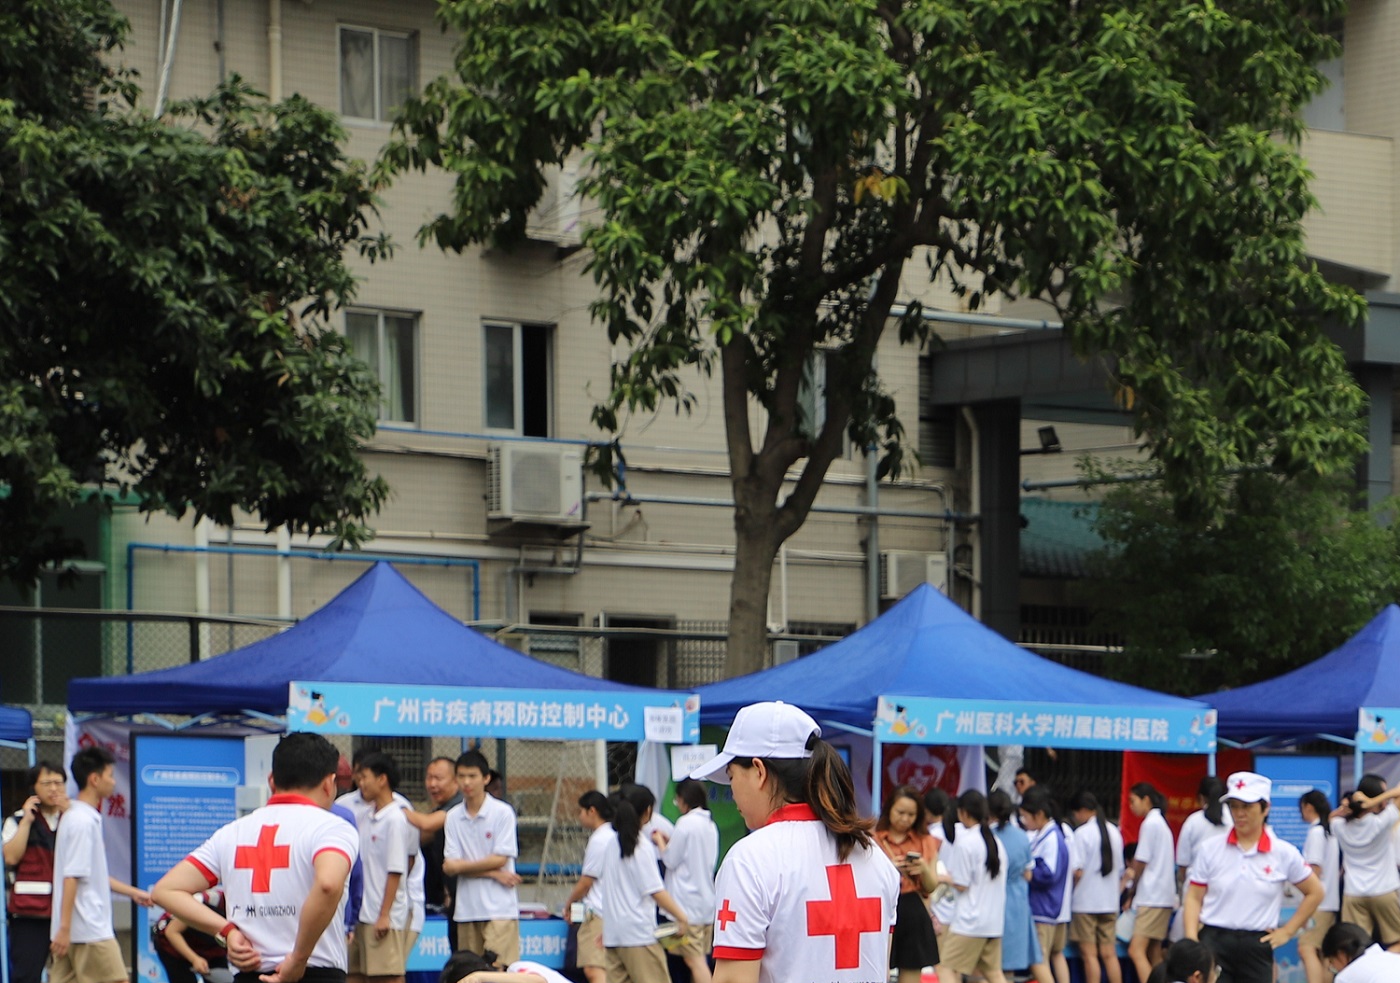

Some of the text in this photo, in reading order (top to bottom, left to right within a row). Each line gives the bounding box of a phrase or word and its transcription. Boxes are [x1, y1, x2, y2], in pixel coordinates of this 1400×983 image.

[373, 698, 629, 729] 广州市疾病预防控制中心
[935, 711, 1169, 742] 广州医科大学附属脑科医院
[519, 933, 567, 957] 控制
